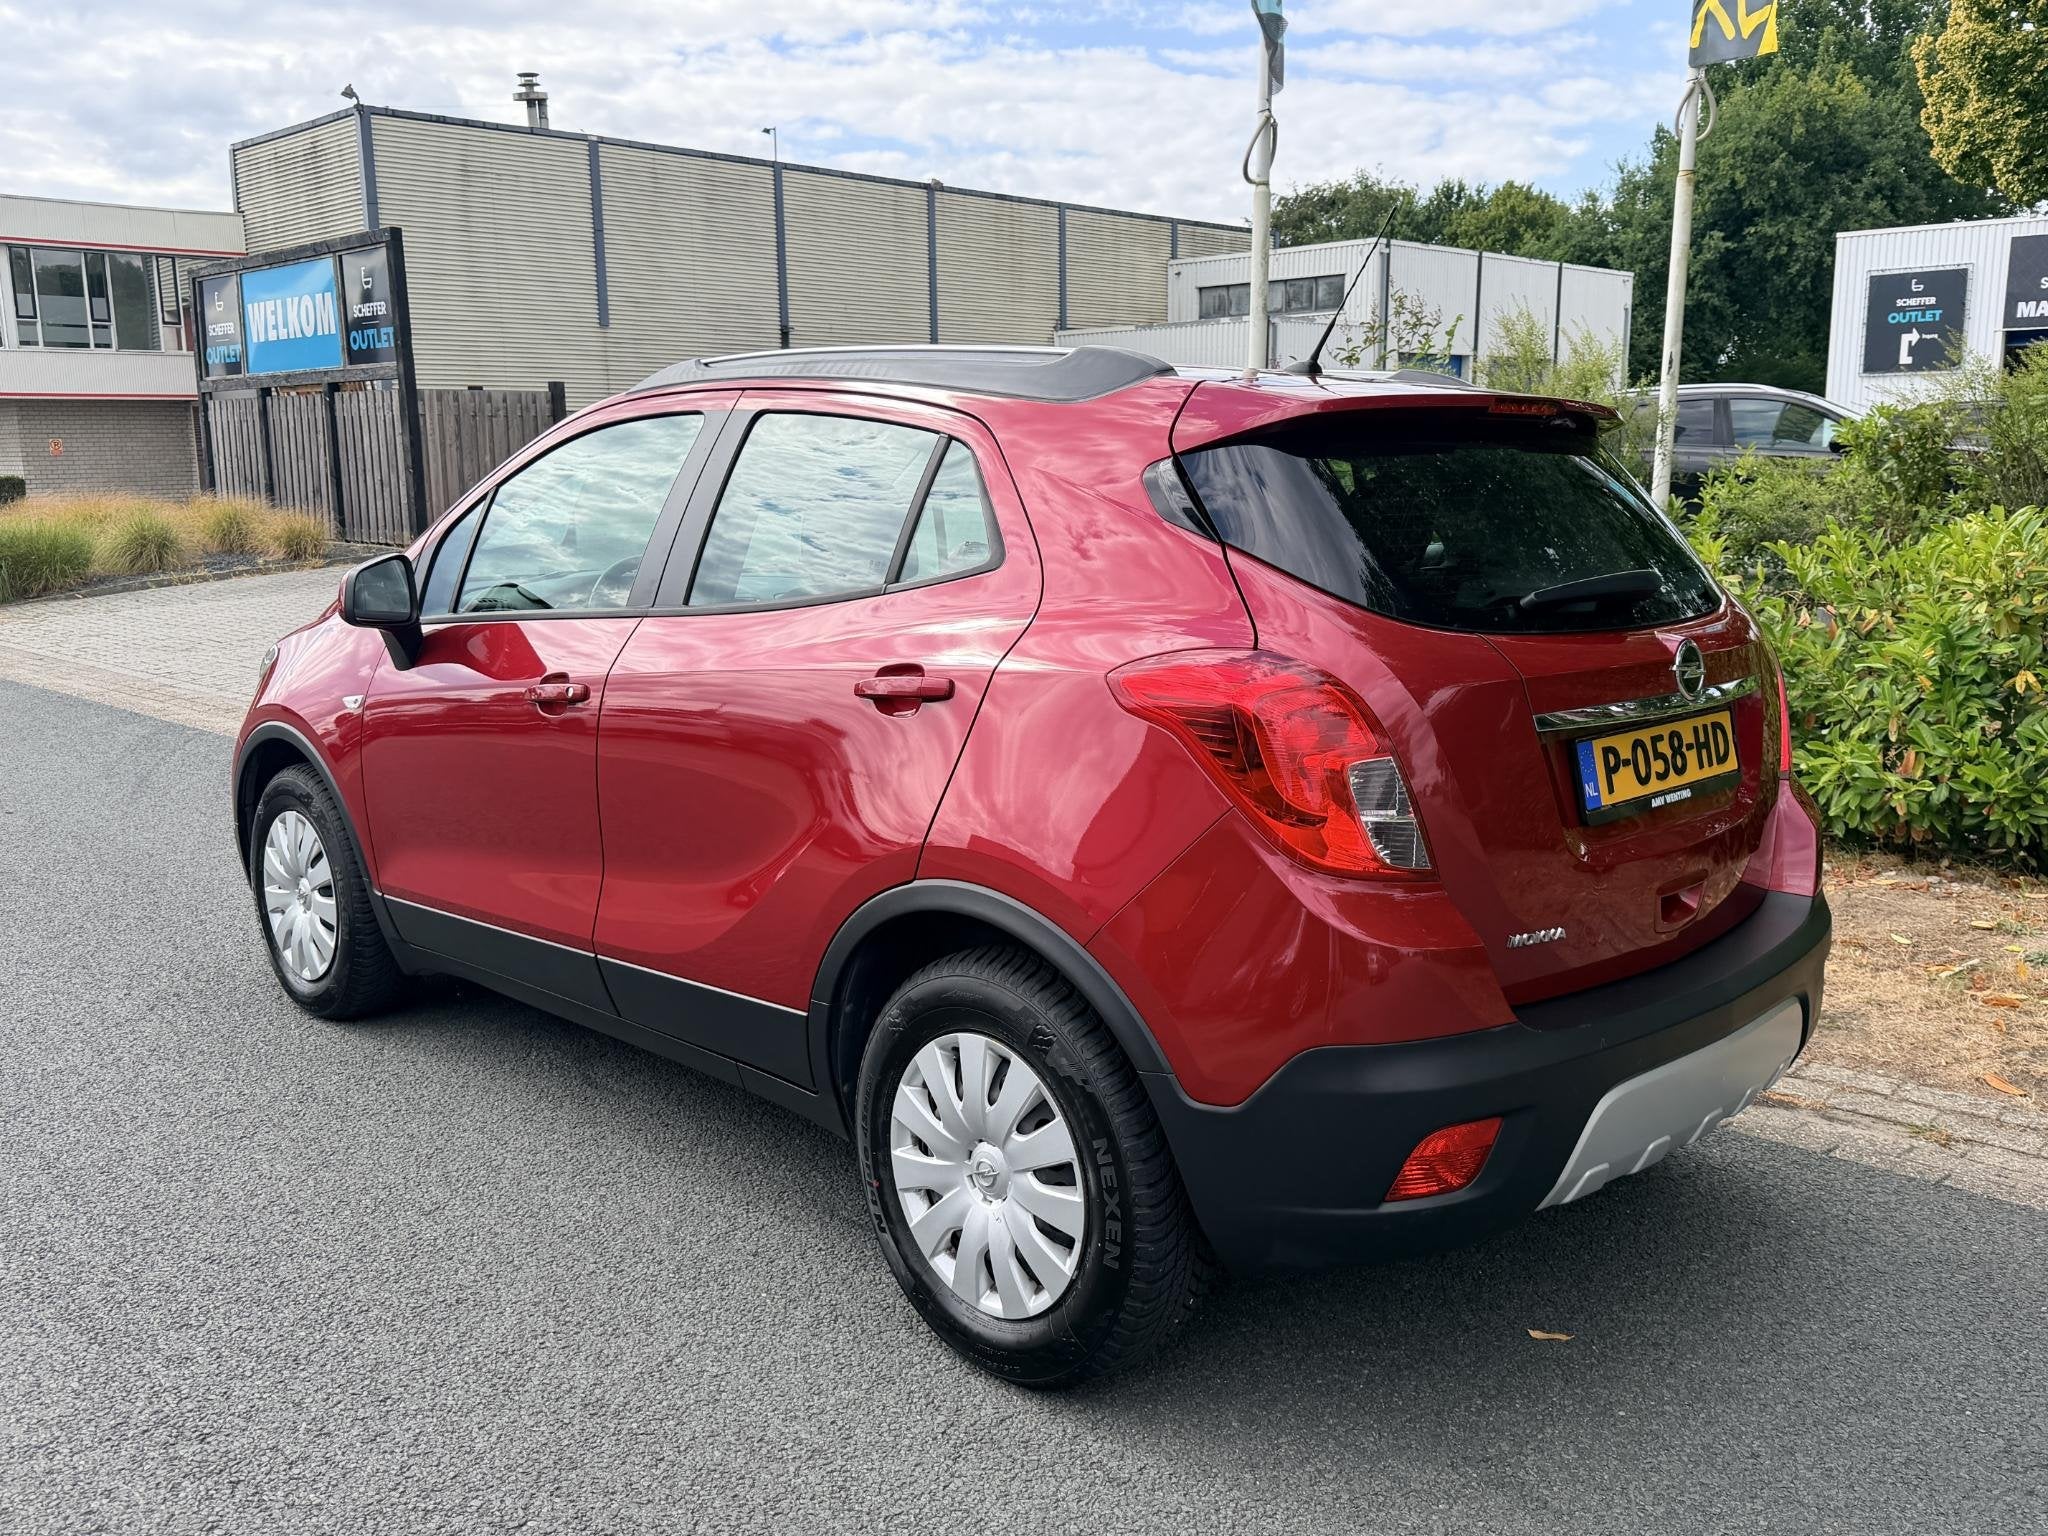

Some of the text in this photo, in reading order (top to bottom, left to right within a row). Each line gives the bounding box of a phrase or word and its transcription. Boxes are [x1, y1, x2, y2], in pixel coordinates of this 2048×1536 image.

[353, 301, 387, 318] SCHEFFER
[1896, 296, 1937, 307] SCHEFFER
[247, 292, 337, 344] WELKOM
[1888, 310, 1943, 324] OUTLET
[208, 321, 235, 337] SCHEFFER
[350, 326, 395, 351] OUTLET
[206, 343, 242, 365] OUTLET
[1601, 721, 1730, 795] P-058-HD
[1585, 783, 1599, 798] NL
[1507, 927, 1567, 948] MOKKA
[1093, 1138, 1123, 1271] NEXEN
